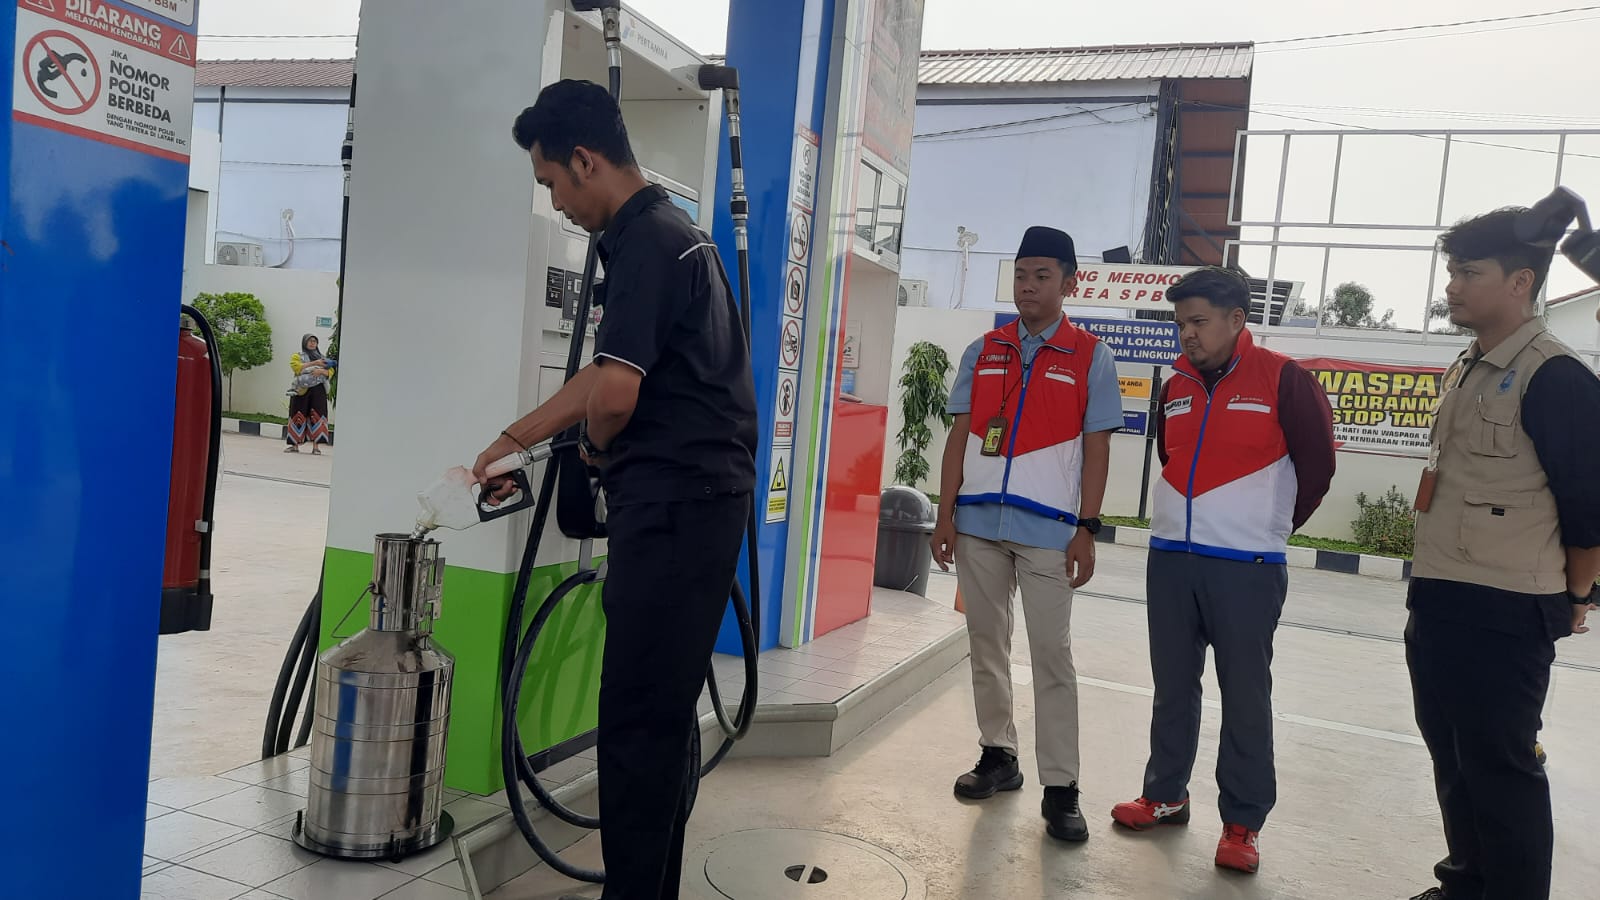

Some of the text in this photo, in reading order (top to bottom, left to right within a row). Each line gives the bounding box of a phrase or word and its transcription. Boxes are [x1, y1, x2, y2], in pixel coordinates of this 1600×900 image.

[154, 0, 178, 12] BBM
[65, 0, 162, 41] DILARANG
[65, 11, 161, 50] MELAYANI KENDARAAN
[110, 50, 128, 61] JIKA
[110, 60, 169, 91] NOMOR
[109, 77, 155, 102] POLISI
[108, 93, 171, 123] BERBEDA
[106, 113, 175, 136] DENGAN NOMOR POLISI
[106, 119, 123, 128] YANG
[150, 130, 156, 138] DI
[1075, 270, 1182, 285] NG MEROKO
[1067, 287, 1164, 302] REA SPB
[1090, 323, 1174, 336] KEBERSIHAN
[1098, 335, 1176, 348] HAN LOKASI
[1133, 349, 1182, 360] LINGKUN
[1311, 371, 1437, 396] WASPA
[1340, 394, 1440, 412] CURANM
[1332, 409, 1434, 428] STOP TAW
[1350, 435, 1399, 446] KENDARAAN
[1401, 440, 1432, 448] TERPAR
[1362, 428, 1379, 436] DAN
[1381, 430, 1420, 439] WASPADA
